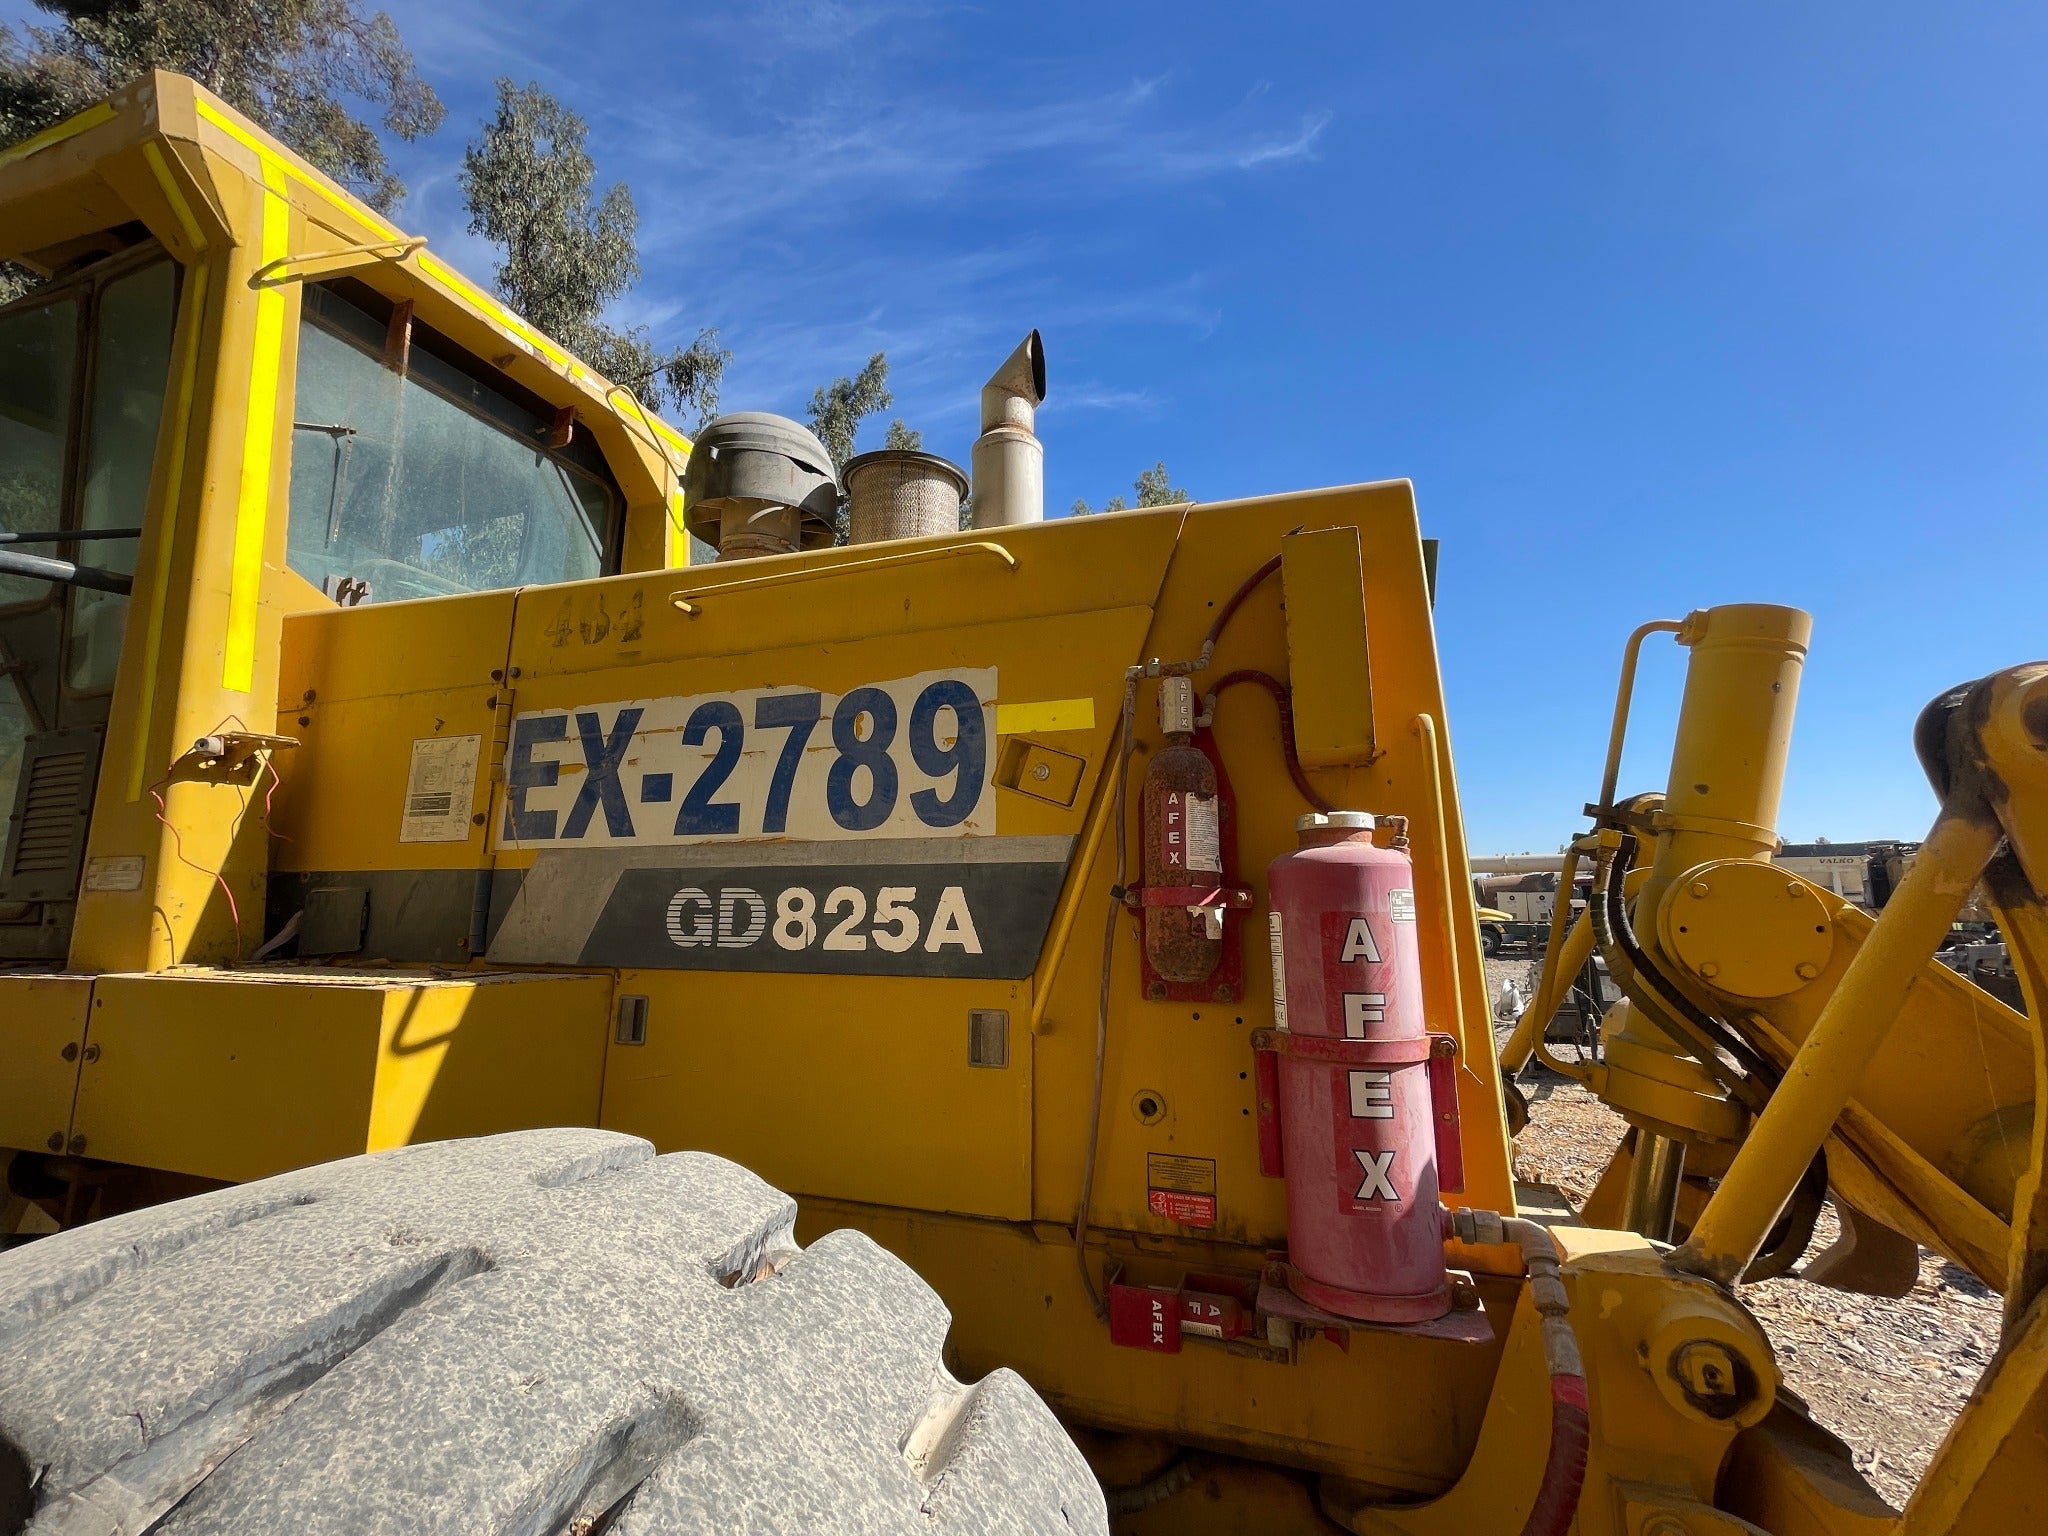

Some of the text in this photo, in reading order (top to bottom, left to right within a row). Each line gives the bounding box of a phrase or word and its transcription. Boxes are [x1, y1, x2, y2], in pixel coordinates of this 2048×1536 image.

[1180, 681, 1188, 729] AFEX
[503, 678, 987, 841] EX-2789
[1168, 792, 1180, 864] AFEX
[665, 885, 984, 954] GD825A
[1339, 917, 1401, 1201] AFEX
[1152, 1299, 1164, 1344] AFEX
